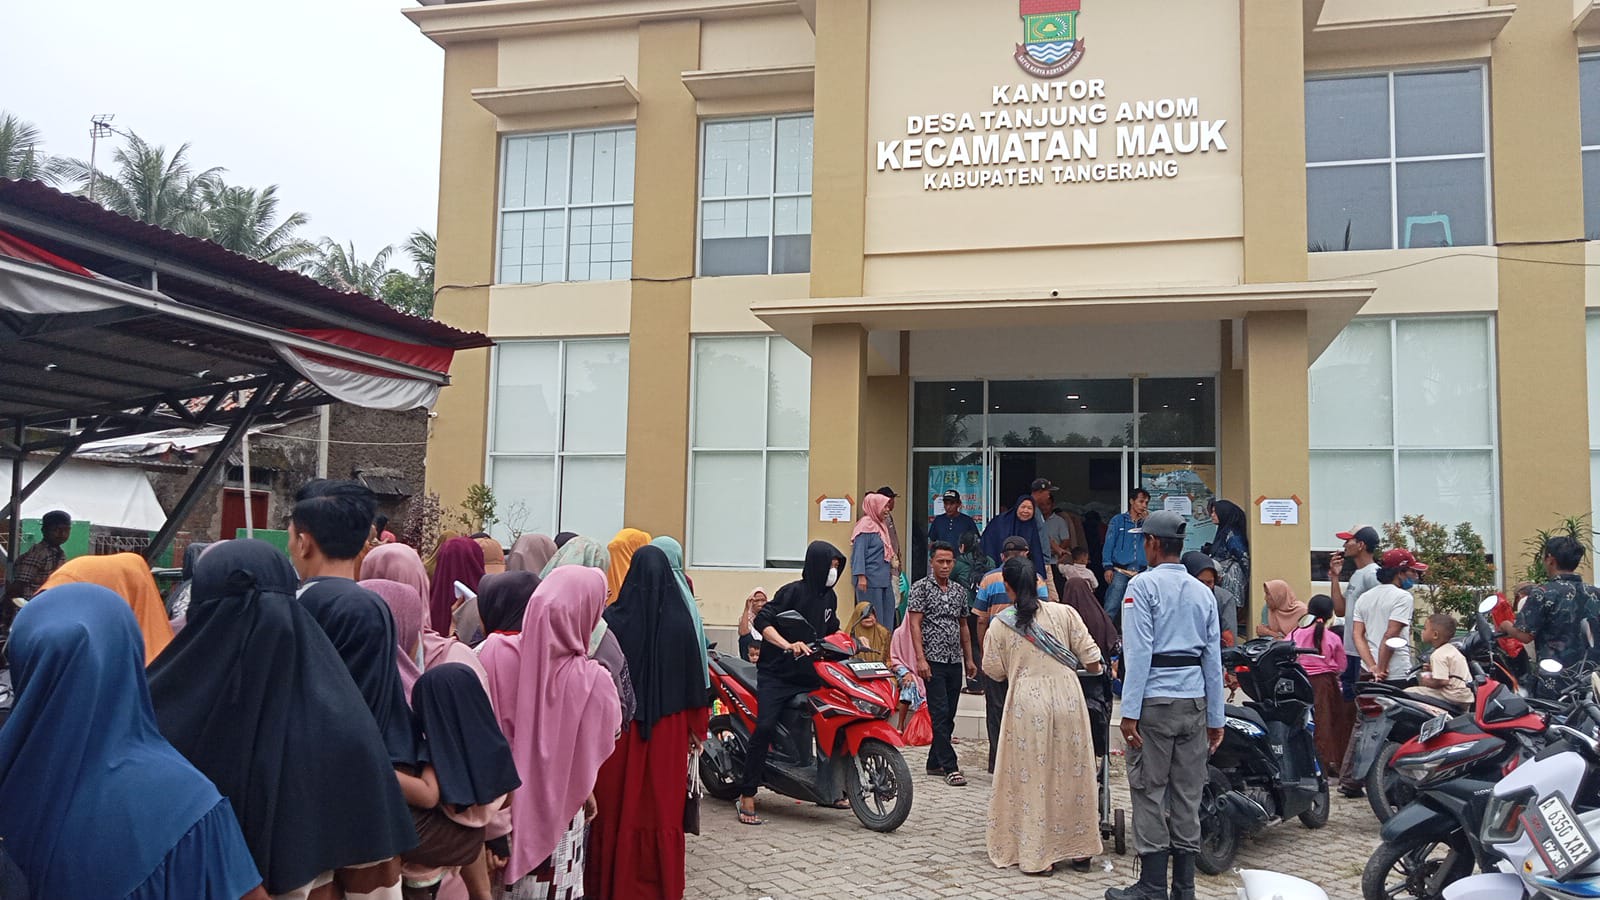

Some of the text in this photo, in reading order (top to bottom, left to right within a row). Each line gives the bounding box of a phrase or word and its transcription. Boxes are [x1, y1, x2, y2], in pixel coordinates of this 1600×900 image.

[992, 78, 1107, 105] KANTOR
[907, 97, 1199, 135] DESA TANJUNG ANOM
[876, 119, 1229, 171] KECAMATAN MAUK
[924, 159, 1179, 190] KABUPATEN TANGERANG
[1541, 799, 1556, 811] A
[1563, 835, 1589, 861] XAX
